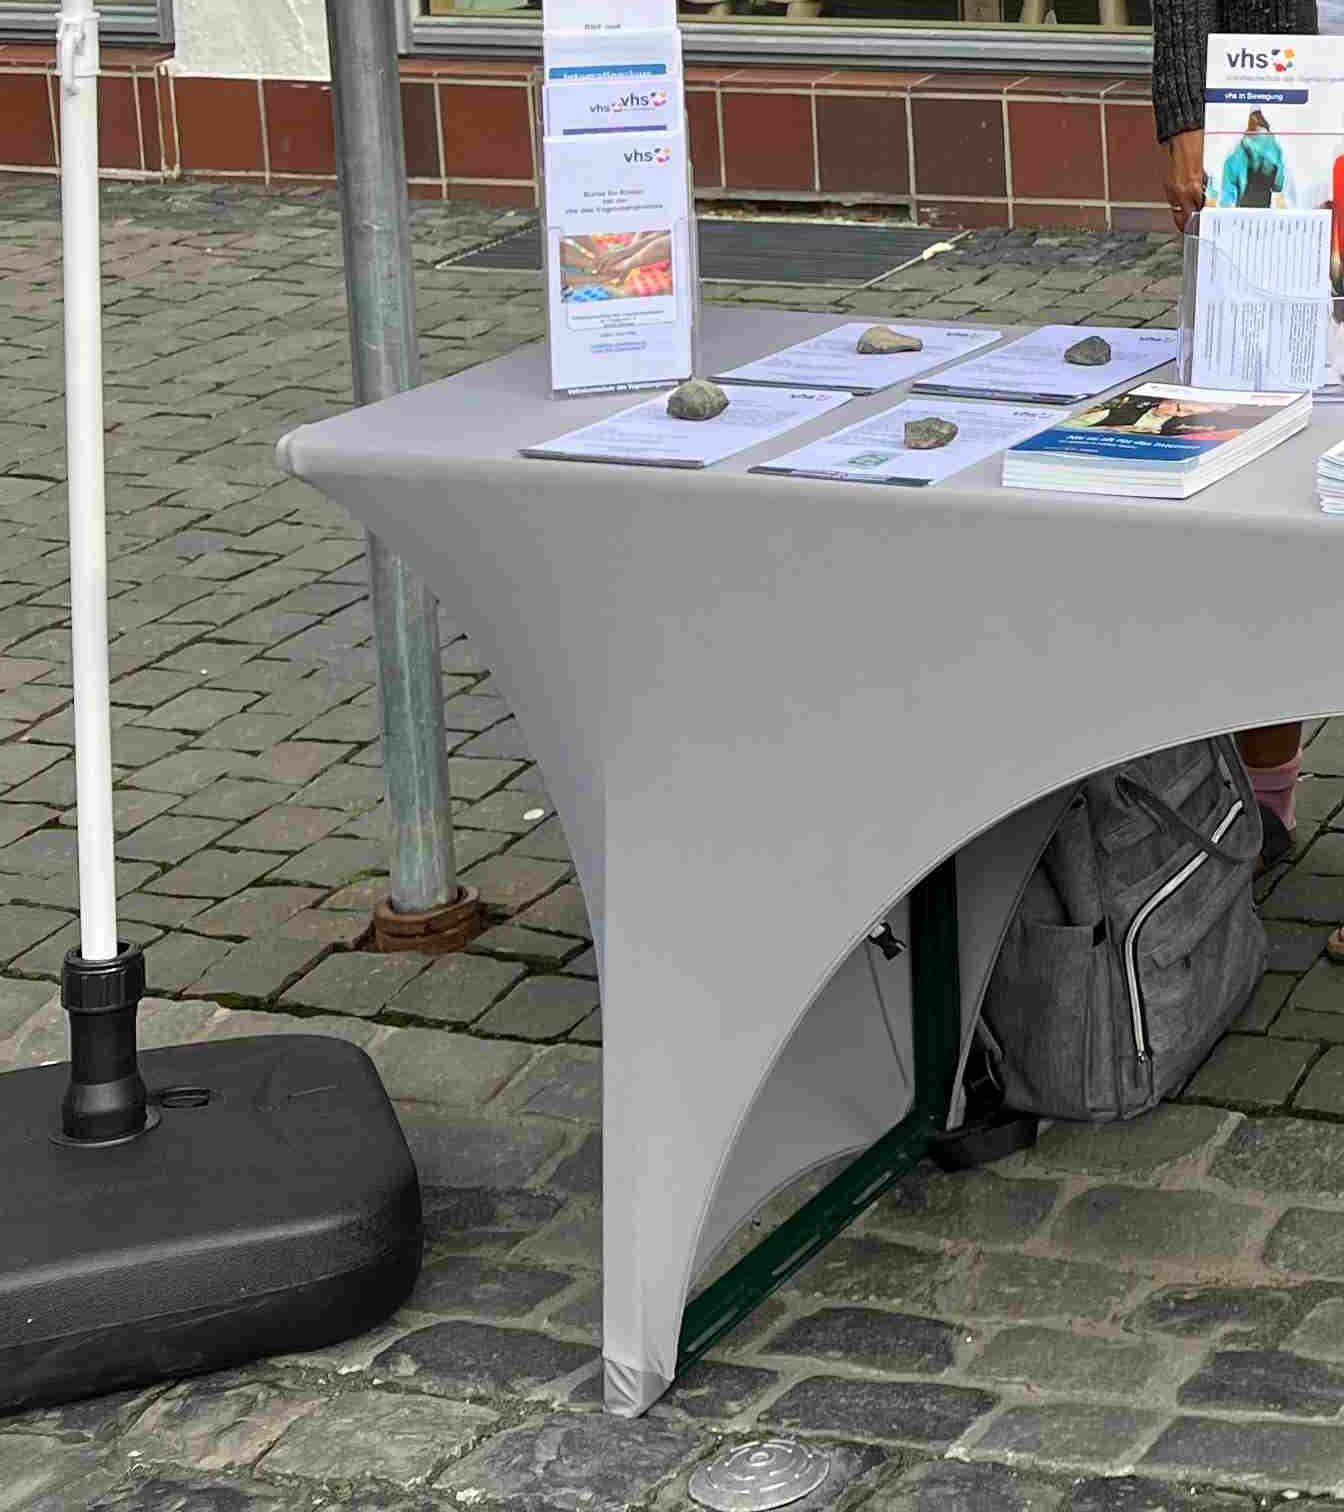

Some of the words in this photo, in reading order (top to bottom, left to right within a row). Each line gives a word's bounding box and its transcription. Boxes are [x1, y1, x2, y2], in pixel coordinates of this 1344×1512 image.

[1225, 48, 1269, 69] vhs
[620, 92, 650, 108] vhs
[589, 103, 610, 113] vhs
[623, 149, 654, 164] vhs
